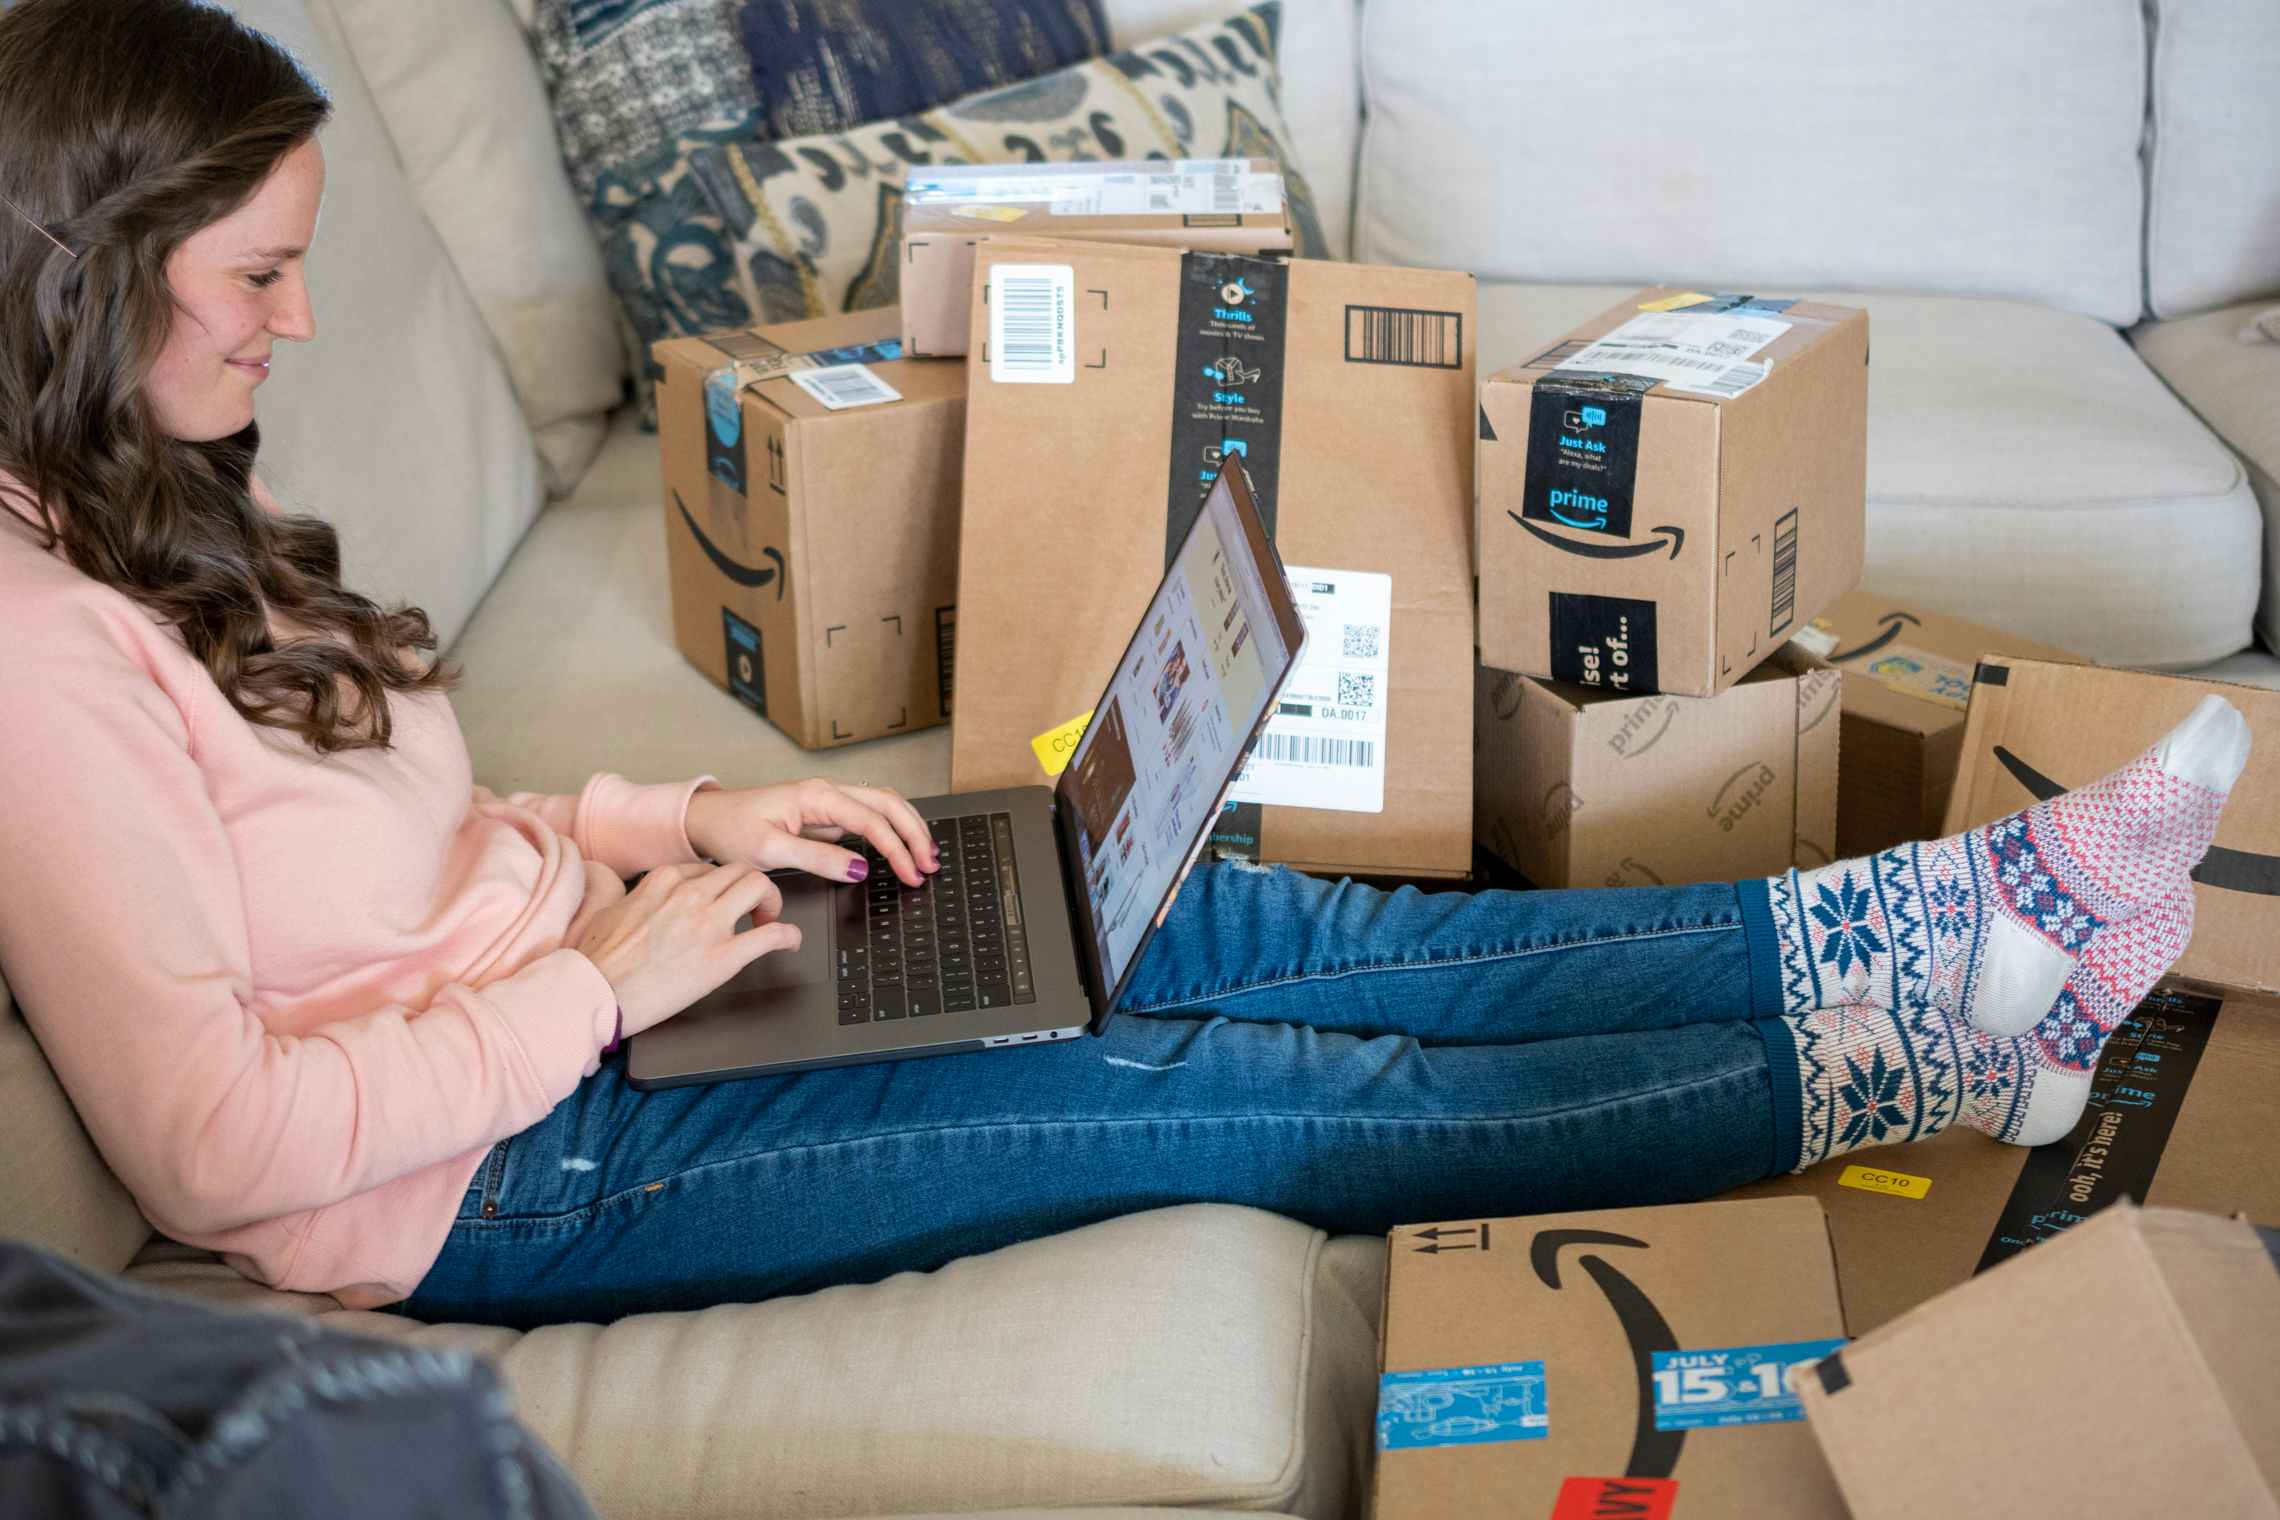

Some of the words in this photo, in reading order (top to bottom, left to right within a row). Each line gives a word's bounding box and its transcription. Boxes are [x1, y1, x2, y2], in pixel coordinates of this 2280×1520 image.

[1213, 308, 1253, 322] Thrills
[1214, 391, 1246, 404] Style
[1559, 436, 1583, 449] Just
[1585, 440, 1606, 453] Ask
[1549, 487, 1609, 513] prime
[1607, 697, 1664, 756] prim
[1718, 765, 1776, 833] prime
[2087, 1112, 2123, 1146] here!
[2076, 1147, 2108, 1169] it's
[2069, 1172, 2103, 1202] ooh,
[1666, 1353, 1730, 1369] JULY
[1652, 1366, 1728, 1406] 15
[1738, 1379, 1758, 1393] &
